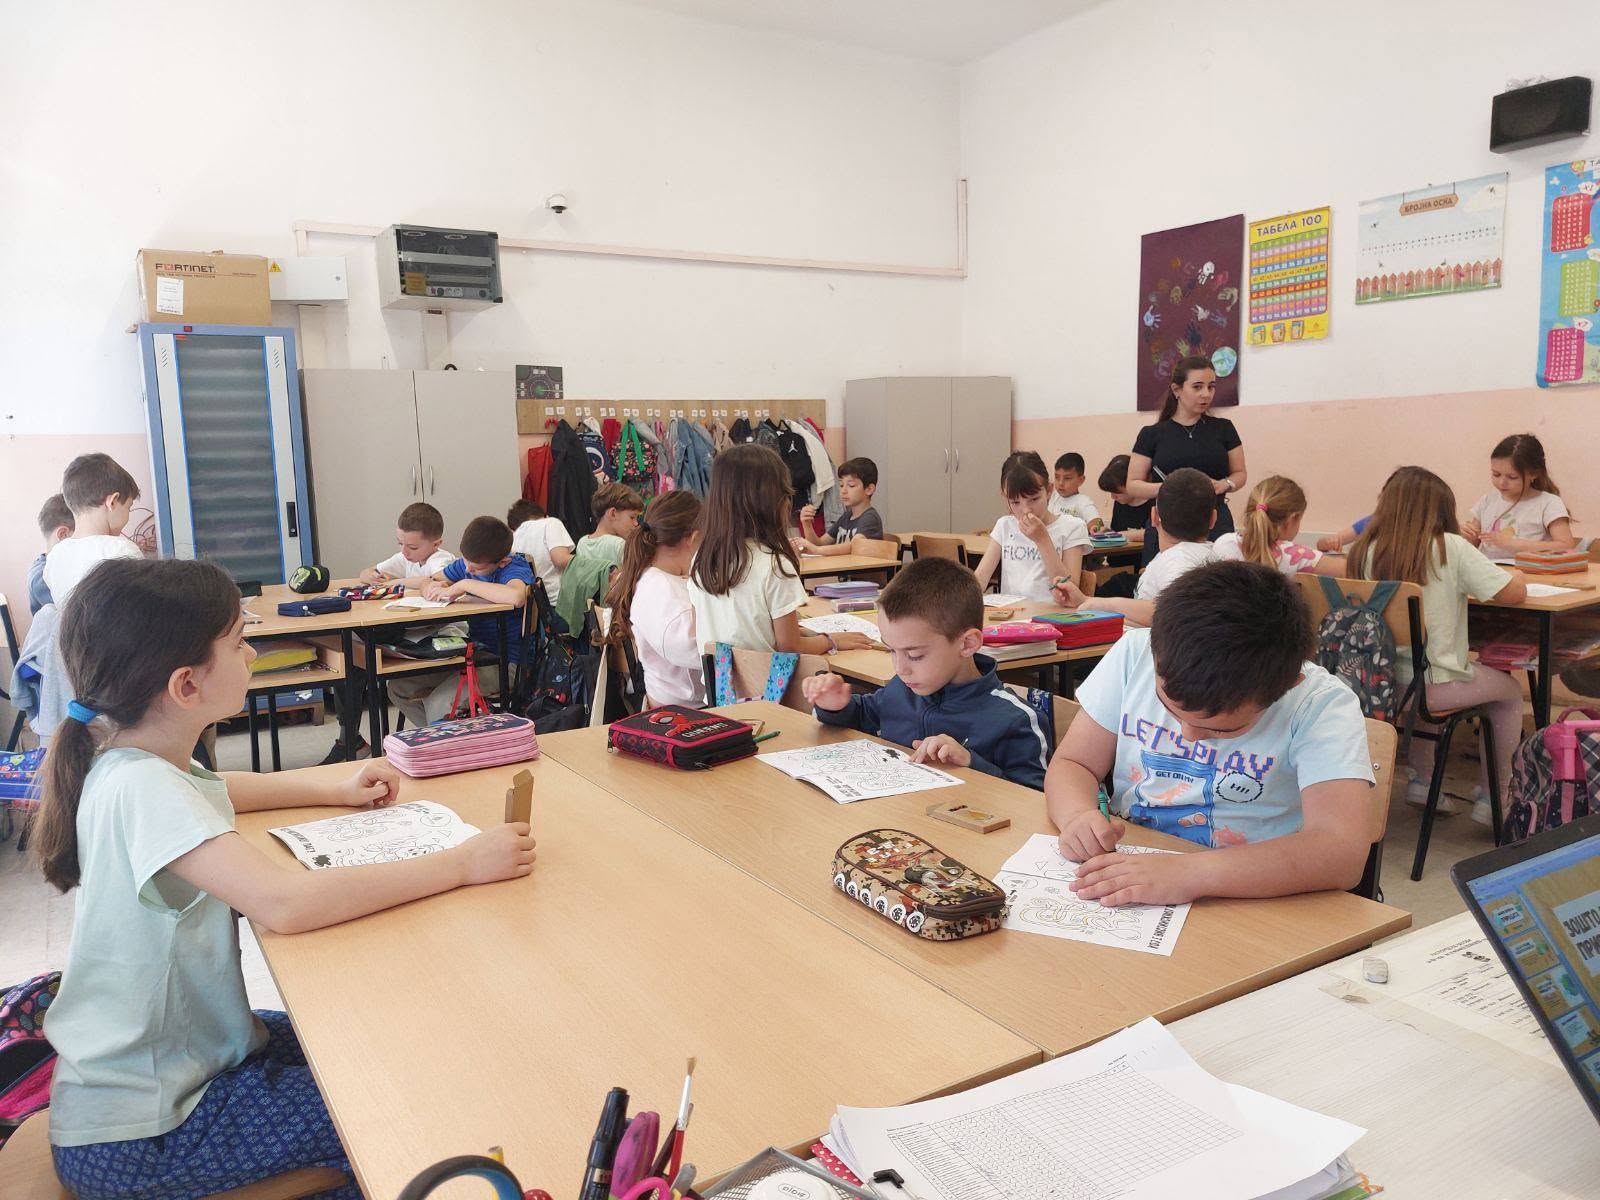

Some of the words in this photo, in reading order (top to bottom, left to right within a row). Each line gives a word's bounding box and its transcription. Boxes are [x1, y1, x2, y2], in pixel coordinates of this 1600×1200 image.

[1257, 220, 1297, 237] ТАБЕЛА
[1302, 214, 1322, 227] 100
[1121, 713, 1190, 758] LET'S
[1191, 741, 1274, 780] PLAY
[1155, 770, 1171, 778] GET
